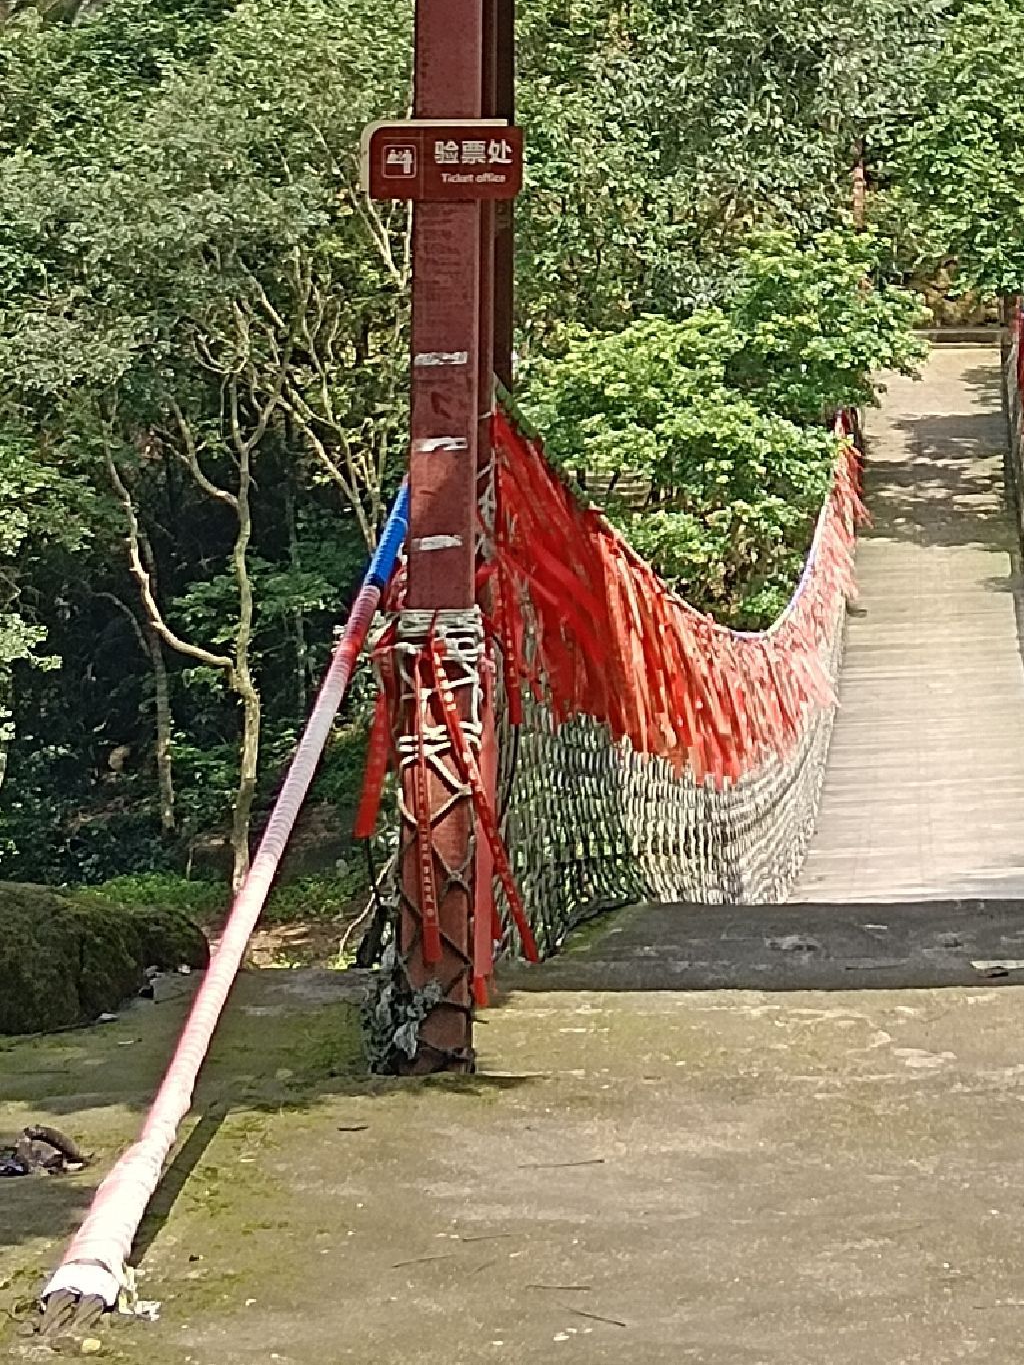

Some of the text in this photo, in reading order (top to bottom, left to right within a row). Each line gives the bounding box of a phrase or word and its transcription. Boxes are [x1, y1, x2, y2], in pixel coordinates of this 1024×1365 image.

[434, 138, 514, 165] 验票处
[441, 173, 474, 183] Ticket
